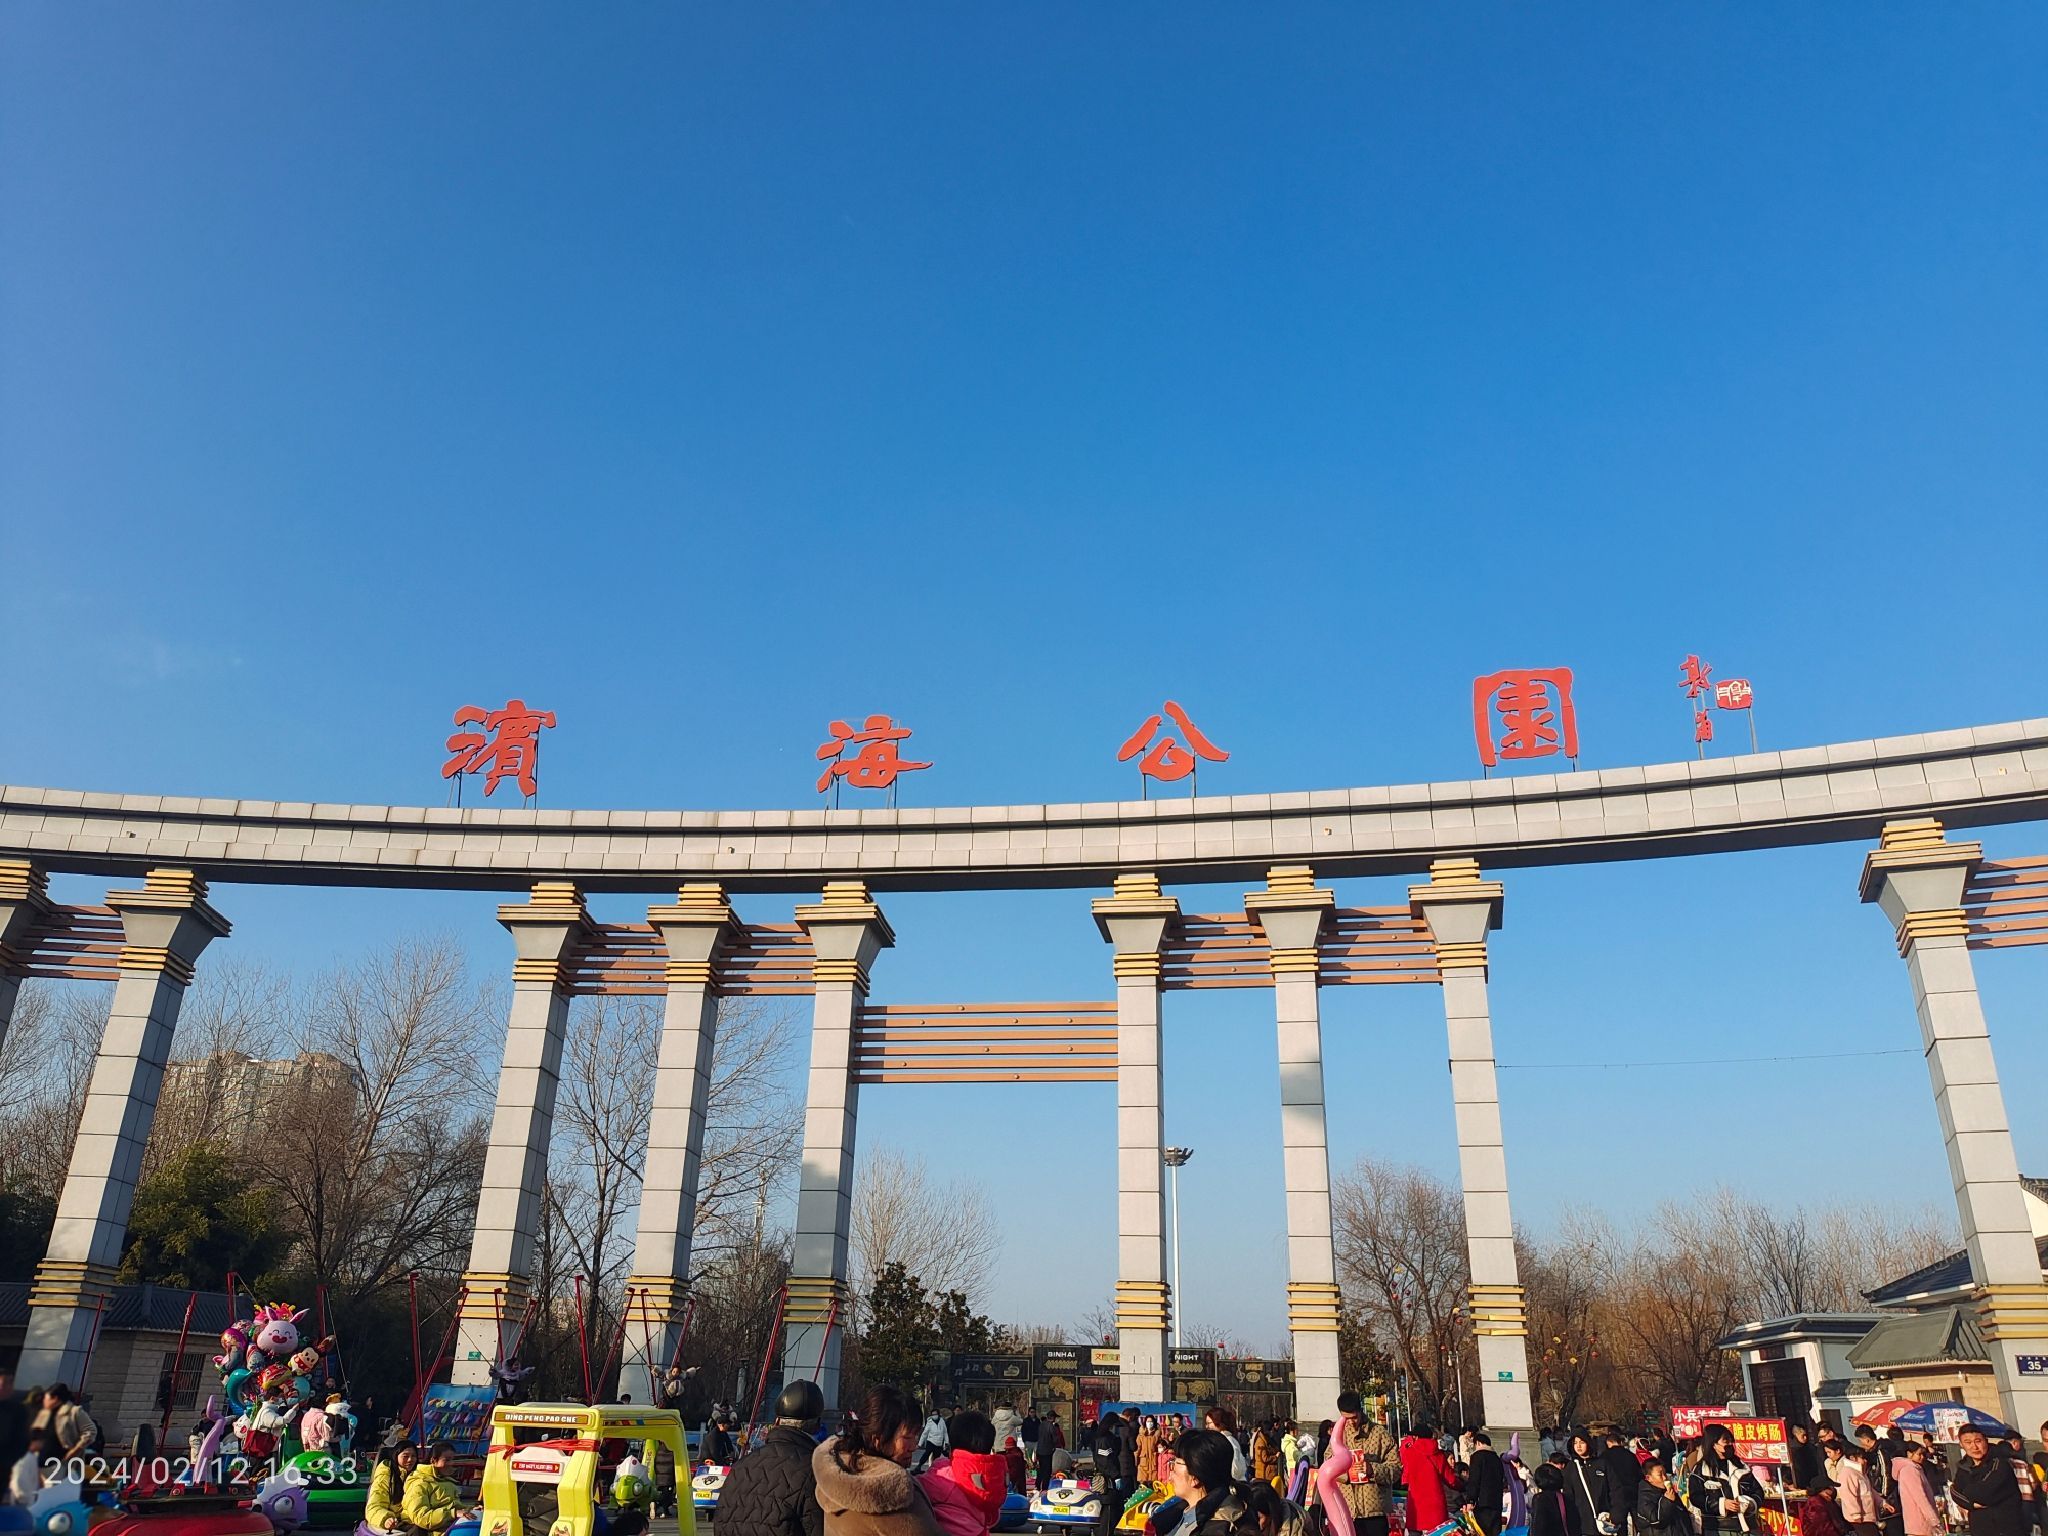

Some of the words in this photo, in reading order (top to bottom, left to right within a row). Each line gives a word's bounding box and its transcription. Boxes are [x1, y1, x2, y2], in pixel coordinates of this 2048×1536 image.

[2027, 1361, 2042, 1370] 35
[1724, 1422, 1782, 1441] 脆皮烤肠
